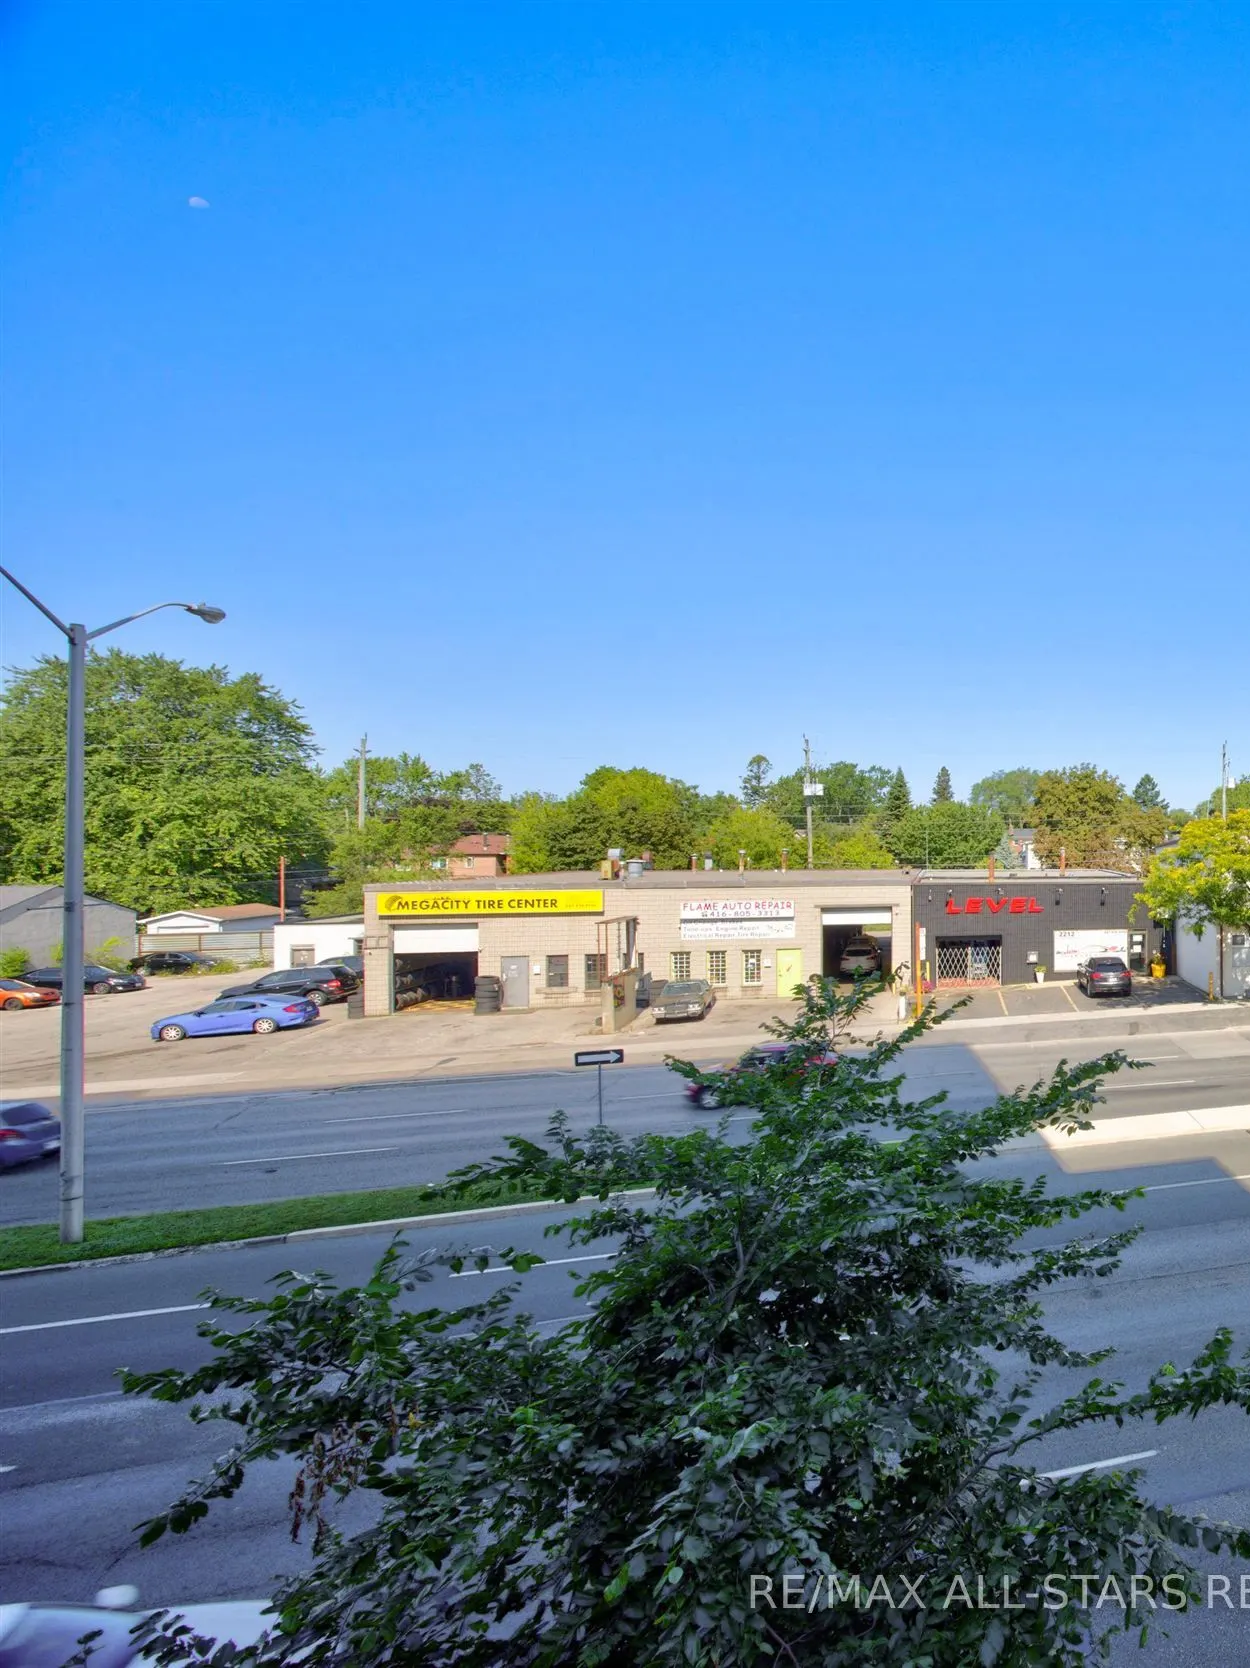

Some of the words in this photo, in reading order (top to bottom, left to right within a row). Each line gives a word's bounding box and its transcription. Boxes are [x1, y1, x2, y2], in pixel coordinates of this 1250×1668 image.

[397, 898, 471, 911] MEGACITY
[476, 899, 503, 909] TIRE
[508, 898, 558, 909] CENTER
[683, 902, 719, 911] FLAME
[722, 902, 752, 911] AUTO
[754, 901, 792, 910] REPAIR
[946, 896, 1044, 914] LEVEL
